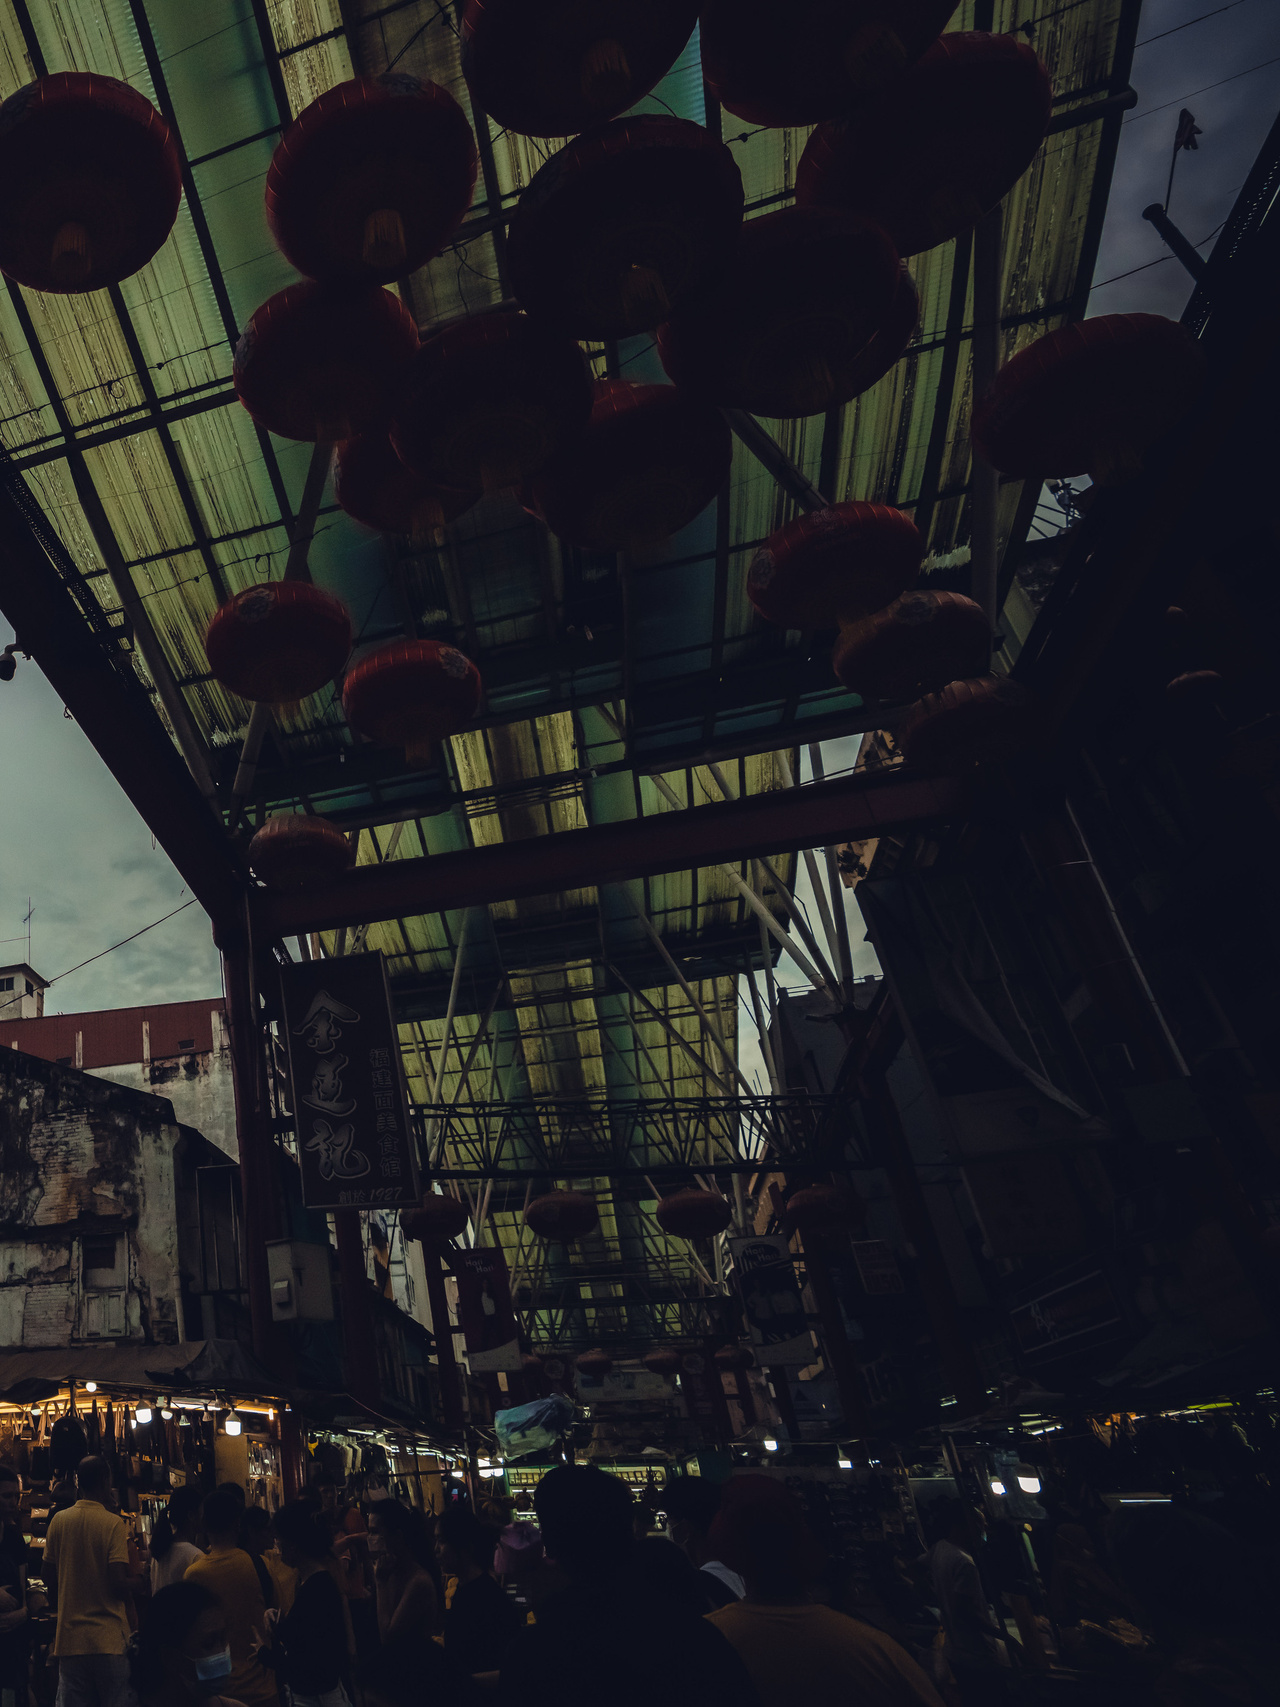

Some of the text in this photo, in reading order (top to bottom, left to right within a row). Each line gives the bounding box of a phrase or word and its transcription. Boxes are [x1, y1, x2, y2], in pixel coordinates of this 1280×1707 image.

[370, 1047, 402, 1178] 福建面美食馆
[369, 1186, 403, 1201] 1927
